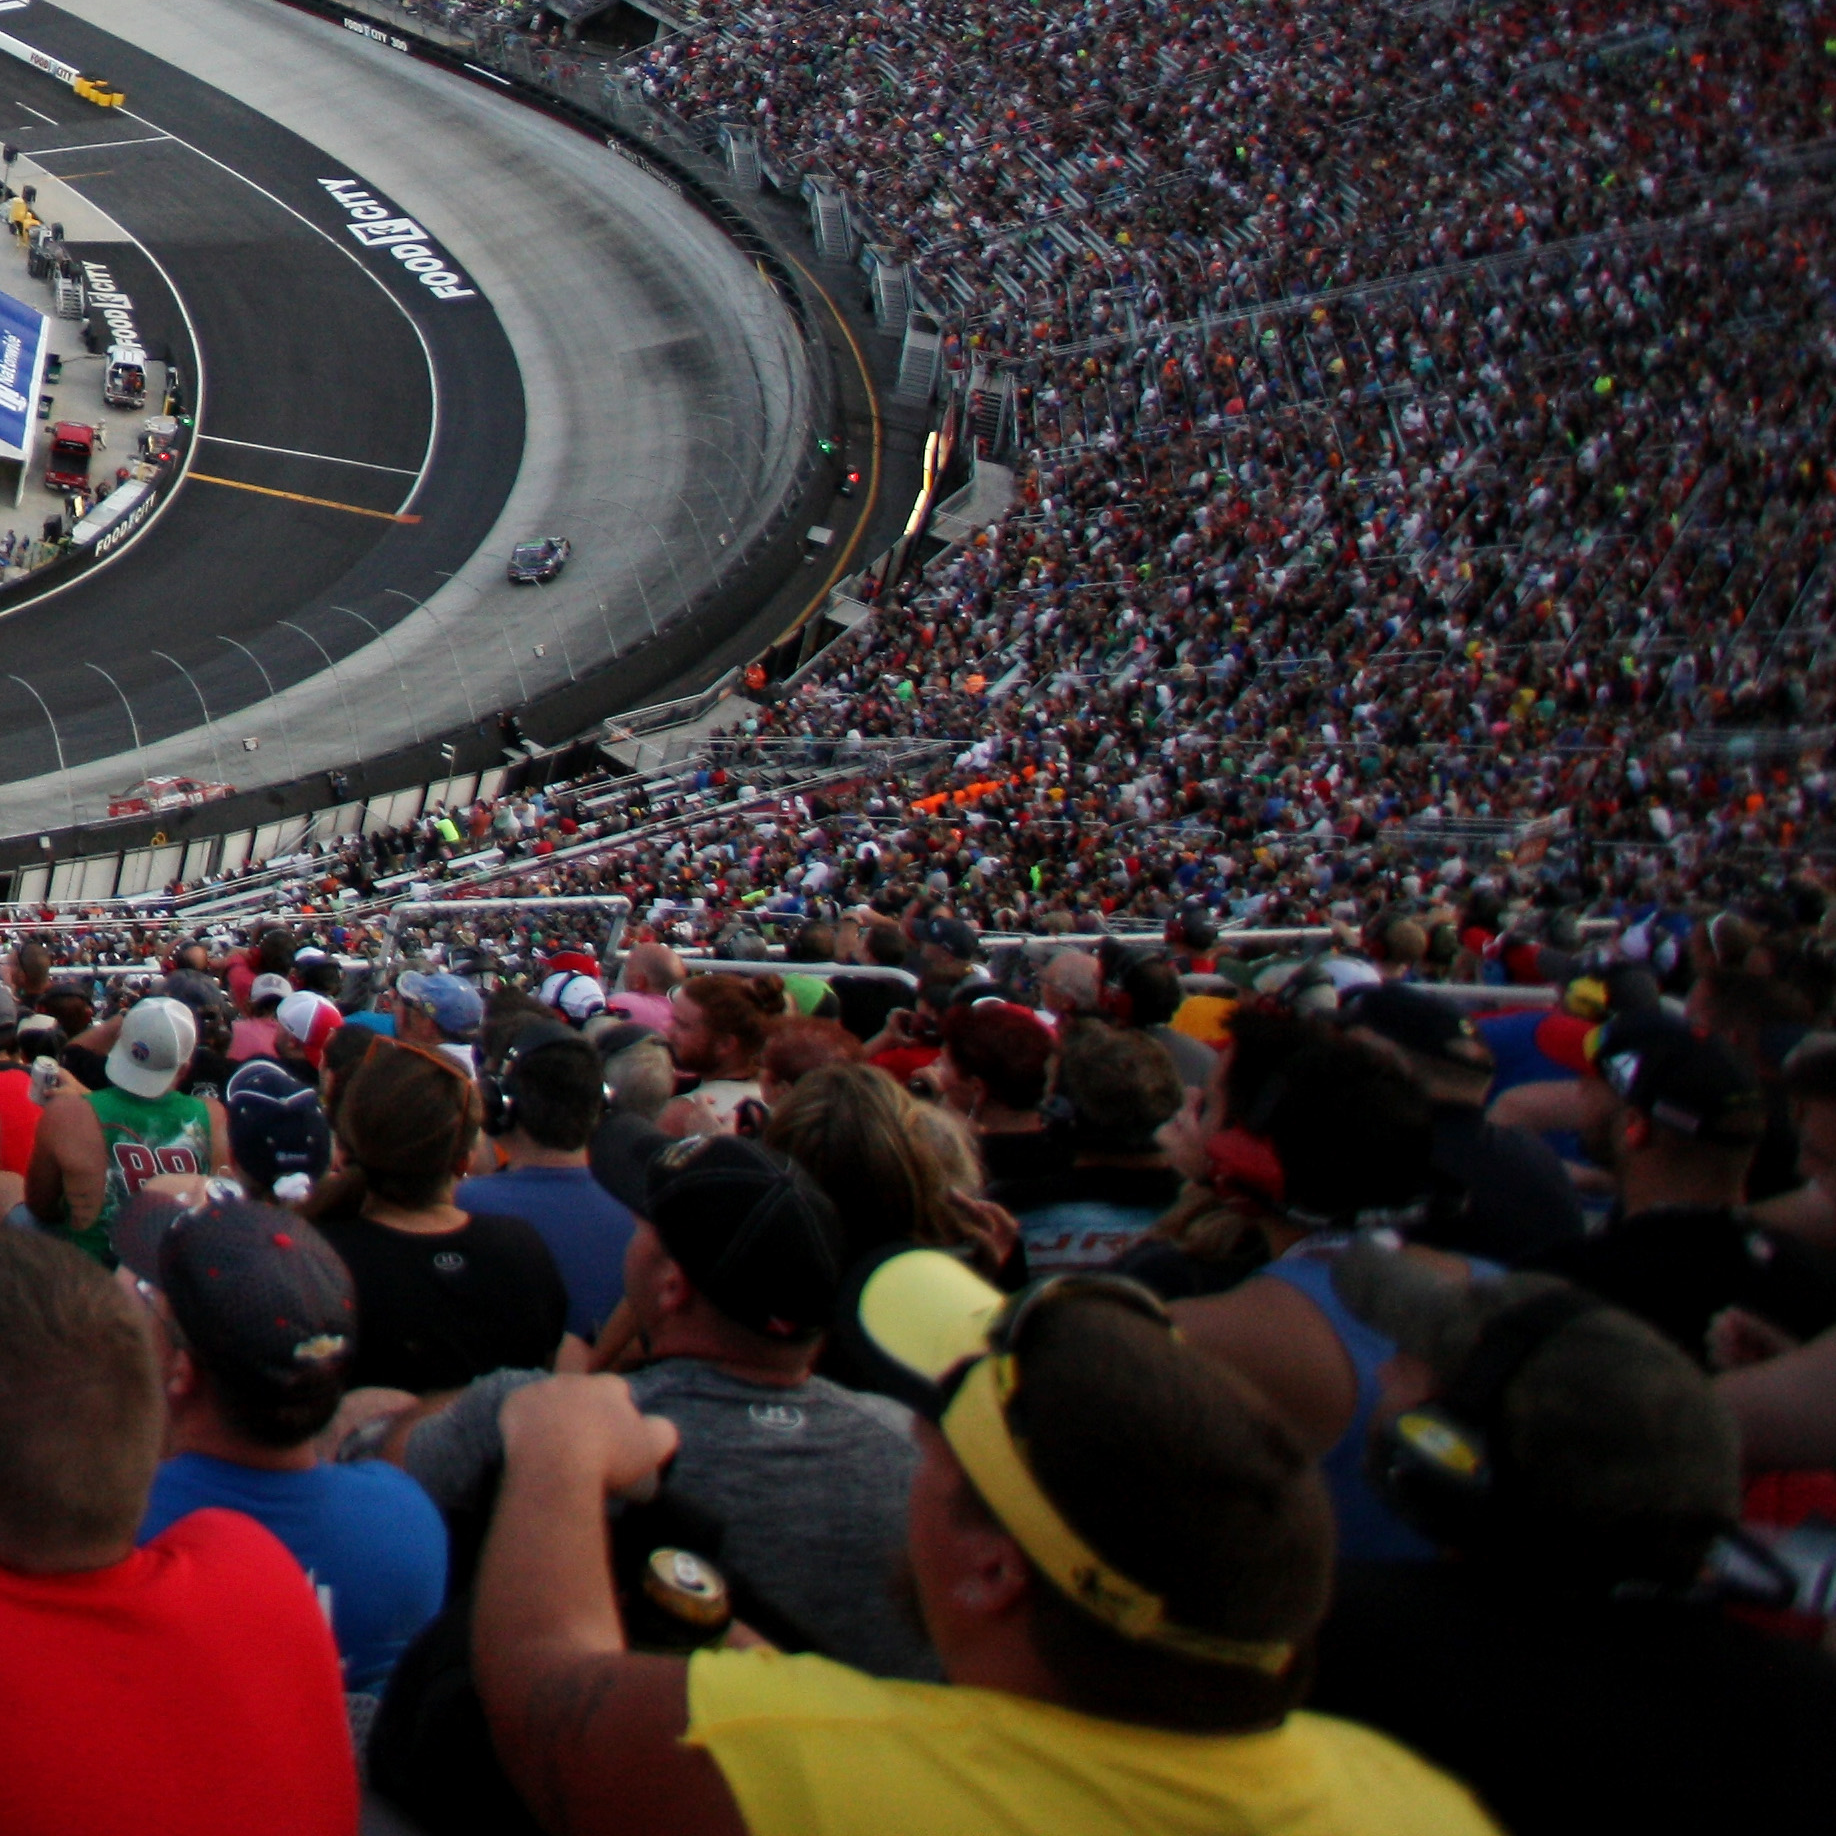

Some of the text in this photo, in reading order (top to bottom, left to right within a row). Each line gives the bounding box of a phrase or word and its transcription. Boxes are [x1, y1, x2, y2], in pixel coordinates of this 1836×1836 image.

[30, 52, 74, 81] FOOD CITY
[316, 177, 476, 299] CITY FOOD
[82, 260, 143, 348] CITY FOOD
[95, 492, 157, 557] FOOD CITY
